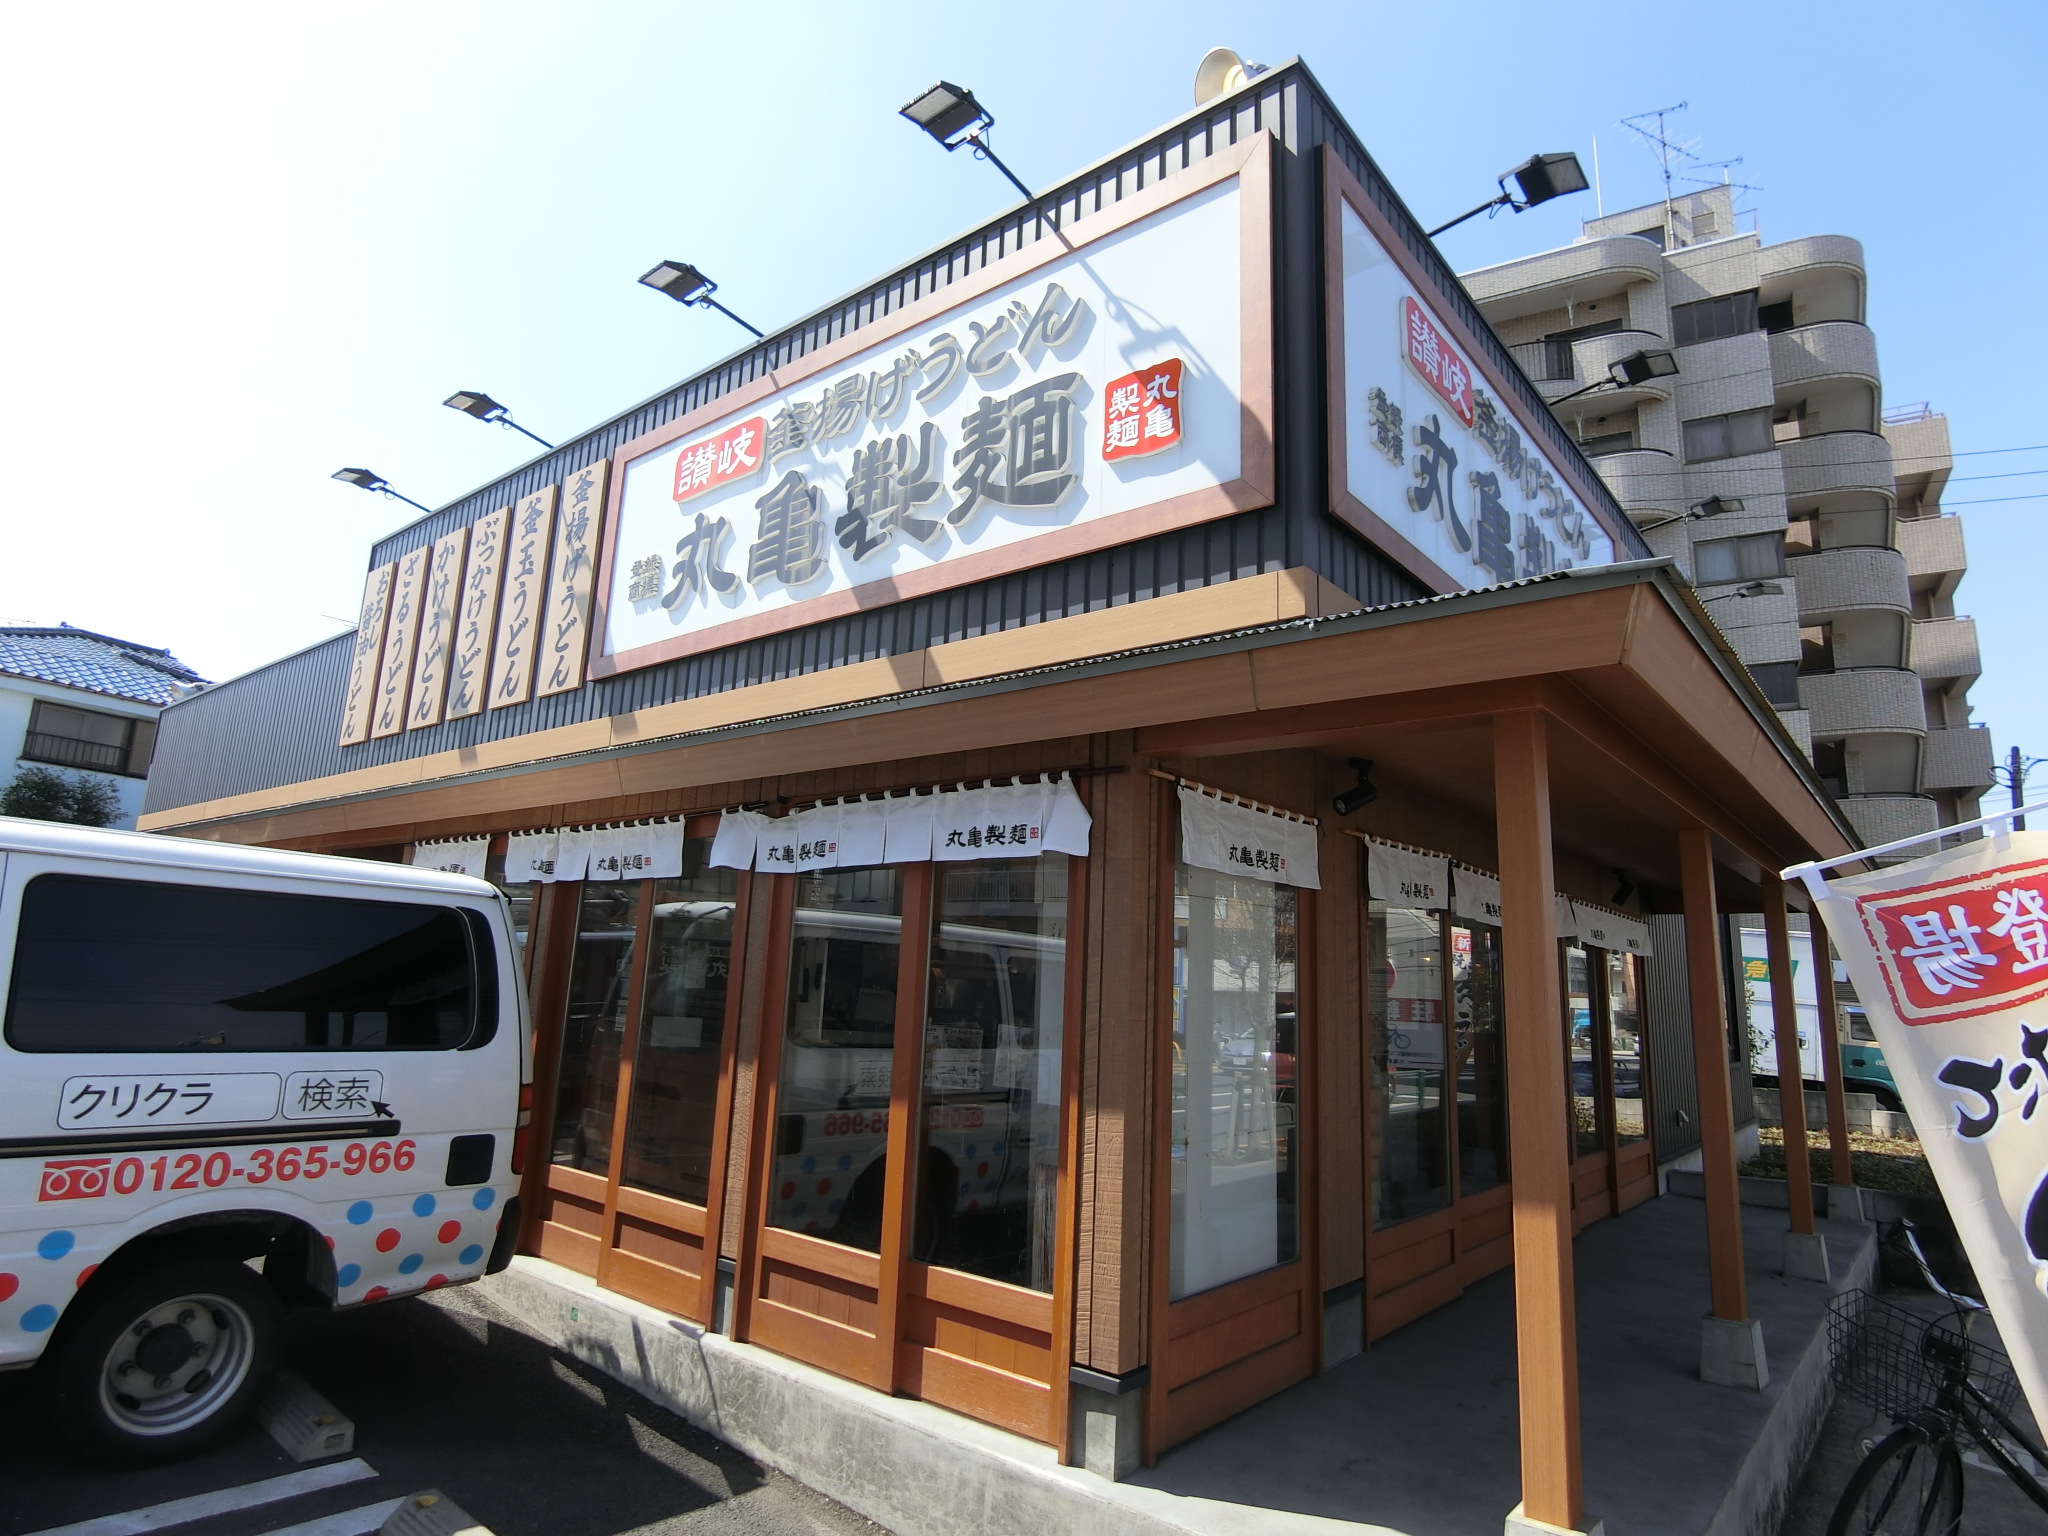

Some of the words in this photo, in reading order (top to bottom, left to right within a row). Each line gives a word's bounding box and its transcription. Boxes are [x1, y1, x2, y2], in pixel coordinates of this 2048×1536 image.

[767, 283, 1087, 464] 釜揚げうどん
[661, 372, 1083, 610] 丸亀製麺
[414, 541, 456, 721] かけうどん
[452, 517, 500, 709] ぶっかけうどん
[499, 497, 544, 700] 釜玉うどん
[548, 470, 595, 690] 釜揚げうどん
[378, 554, 420, 730] ざるうどん
[596, 854, 643, 871] 丸亀製麺
[767, 839, 827, 863] 丸亀製麺
[945, 824, 1027, 848] 丸亀製麺
[1229, 844, 1280, 872] 丸亀製麺
[70, 1082, 213, 1120] クリクラ
[298, 1076, 370, 1112] 検索
[113, 1139, 416, 1195] 0120-365-966
